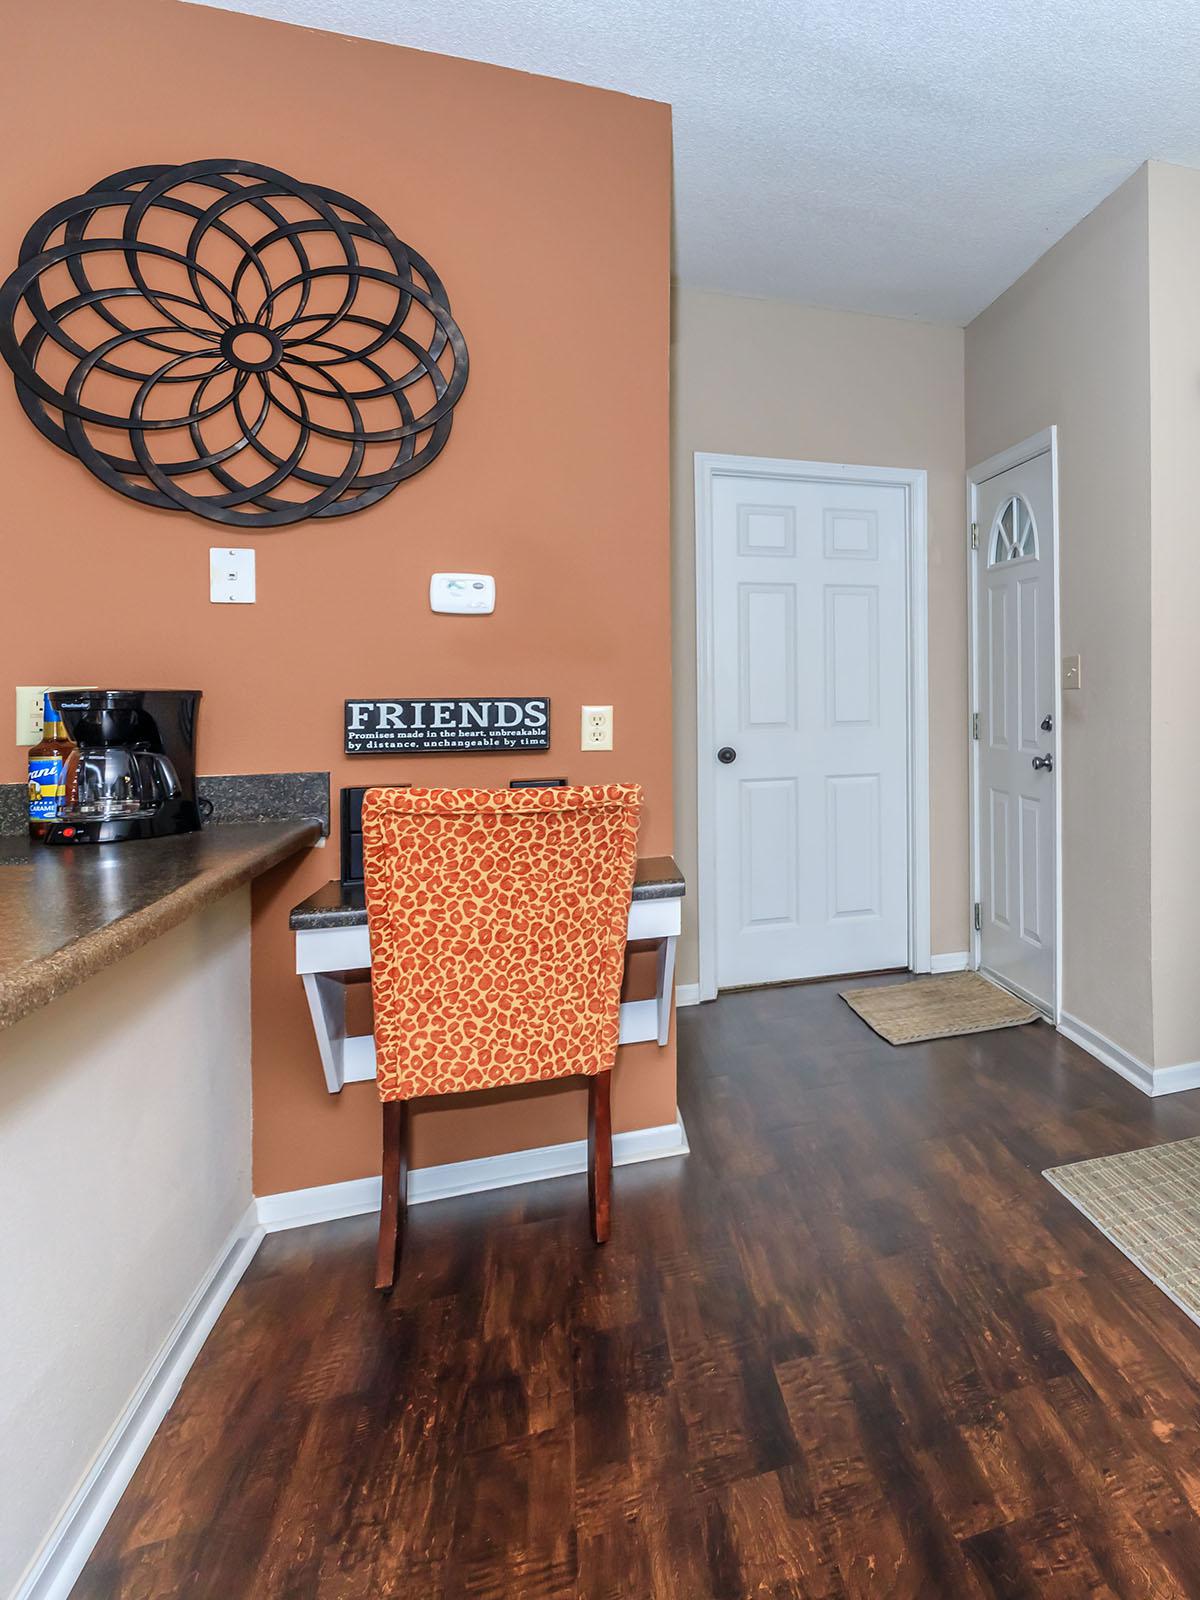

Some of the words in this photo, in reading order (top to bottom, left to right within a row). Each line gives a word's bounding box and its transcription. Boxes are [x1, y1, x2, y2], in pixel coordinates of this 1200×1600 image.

[347, 701, 547, 730] FRIENDS
[348, 731, 395, 740] Promises
[397, 730, 424, 738] made
[426, 730, 437, 738] in
[440, 729, 456, 737] the
[489, 728, 547, 736] unbreakable
[348, 741, 362, 751] by
[366, 740, 419, 749] distance,
[423, 738, 500, 748] unchangeable
[504, 737, 516, 747] by
[520, 737, 547, 745] time.
[28, 761, 57, 779] rani
